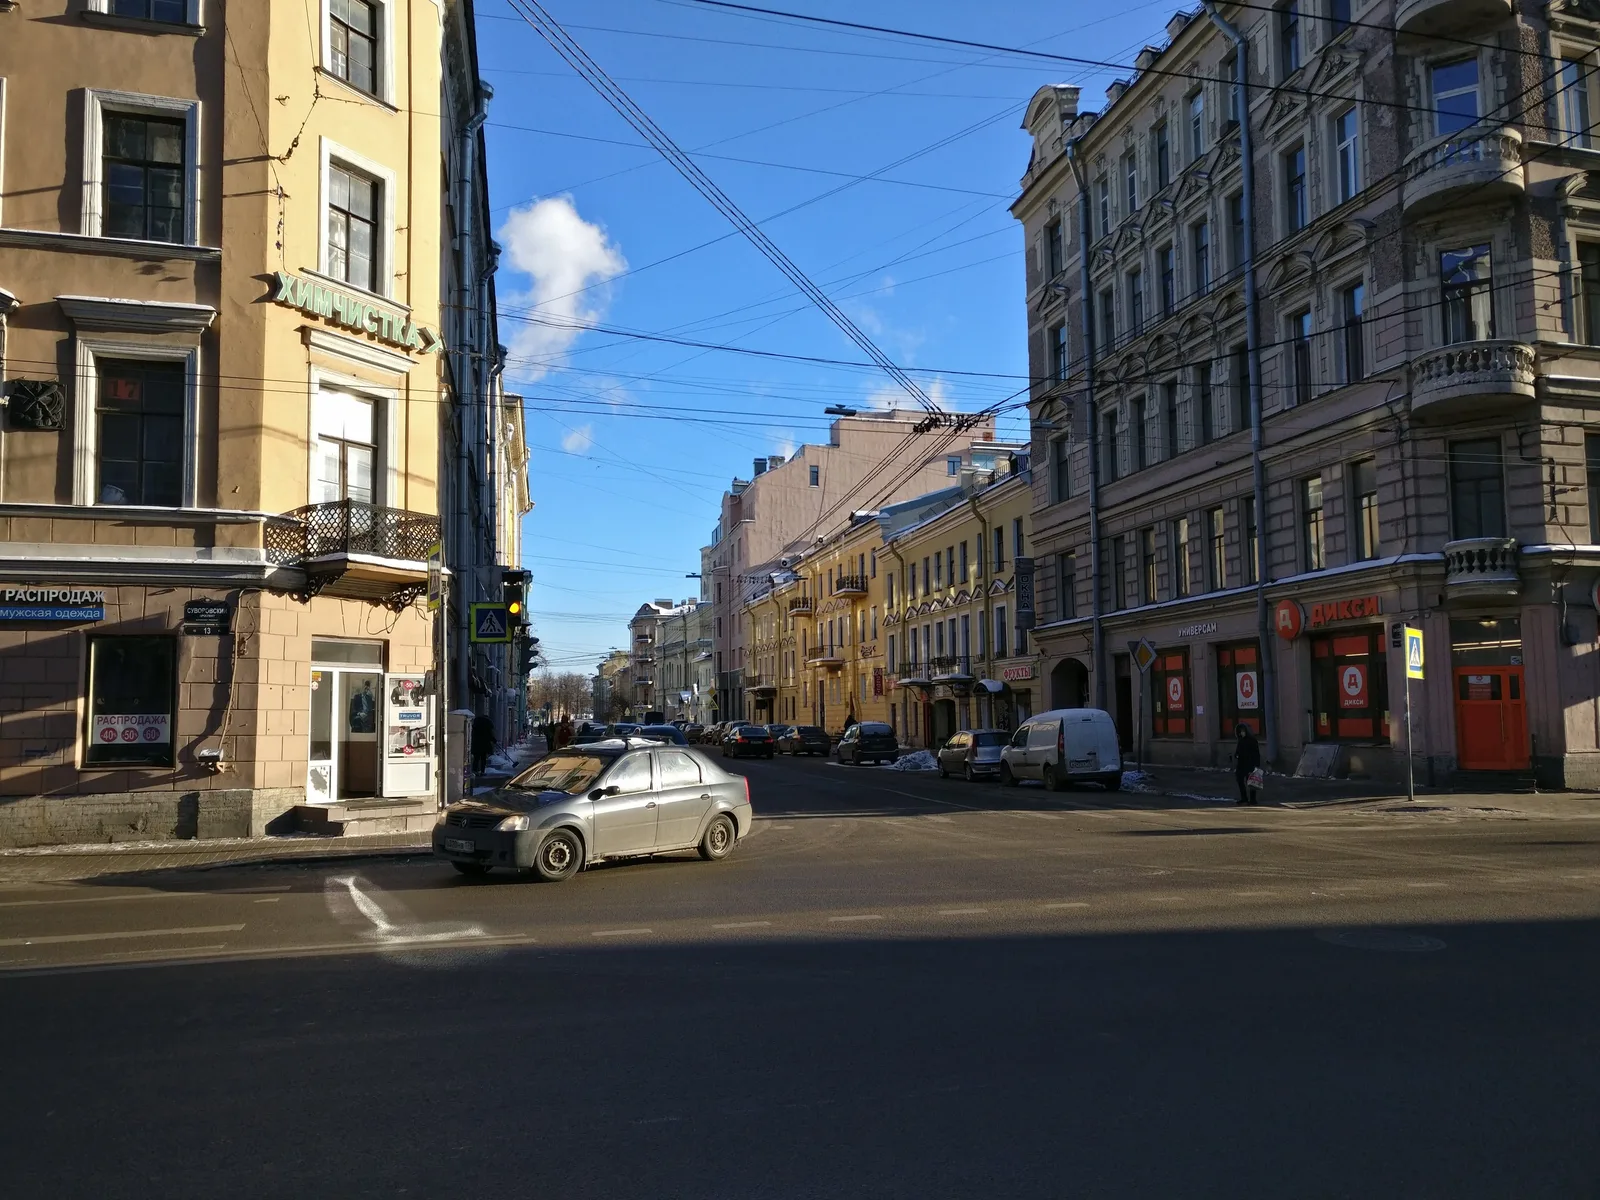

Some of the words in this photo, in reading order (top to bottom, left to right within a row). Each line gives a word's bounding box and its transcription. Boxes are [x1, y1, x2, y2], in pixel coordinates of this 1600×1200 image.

[277, 271, 420, 349] ХИМЧИСТКА
[1020, 574, 1031, 609] ОКНА
[0, 609, 51, 619] мужская
[55, 609, 100, 619] одежда
[1311, 595, 1379, 627] ДИКСИ
[203, 627, 211, 635] 13
[1178, 622, 1217, 637] УНИВЕРСАМ
[1004, 666, 1032, 680] ФРУКТЫ
[1344, 699, 1364, 707] ДИКСИ
[97, 715, 168, 726] РАСПРОДАЖА
